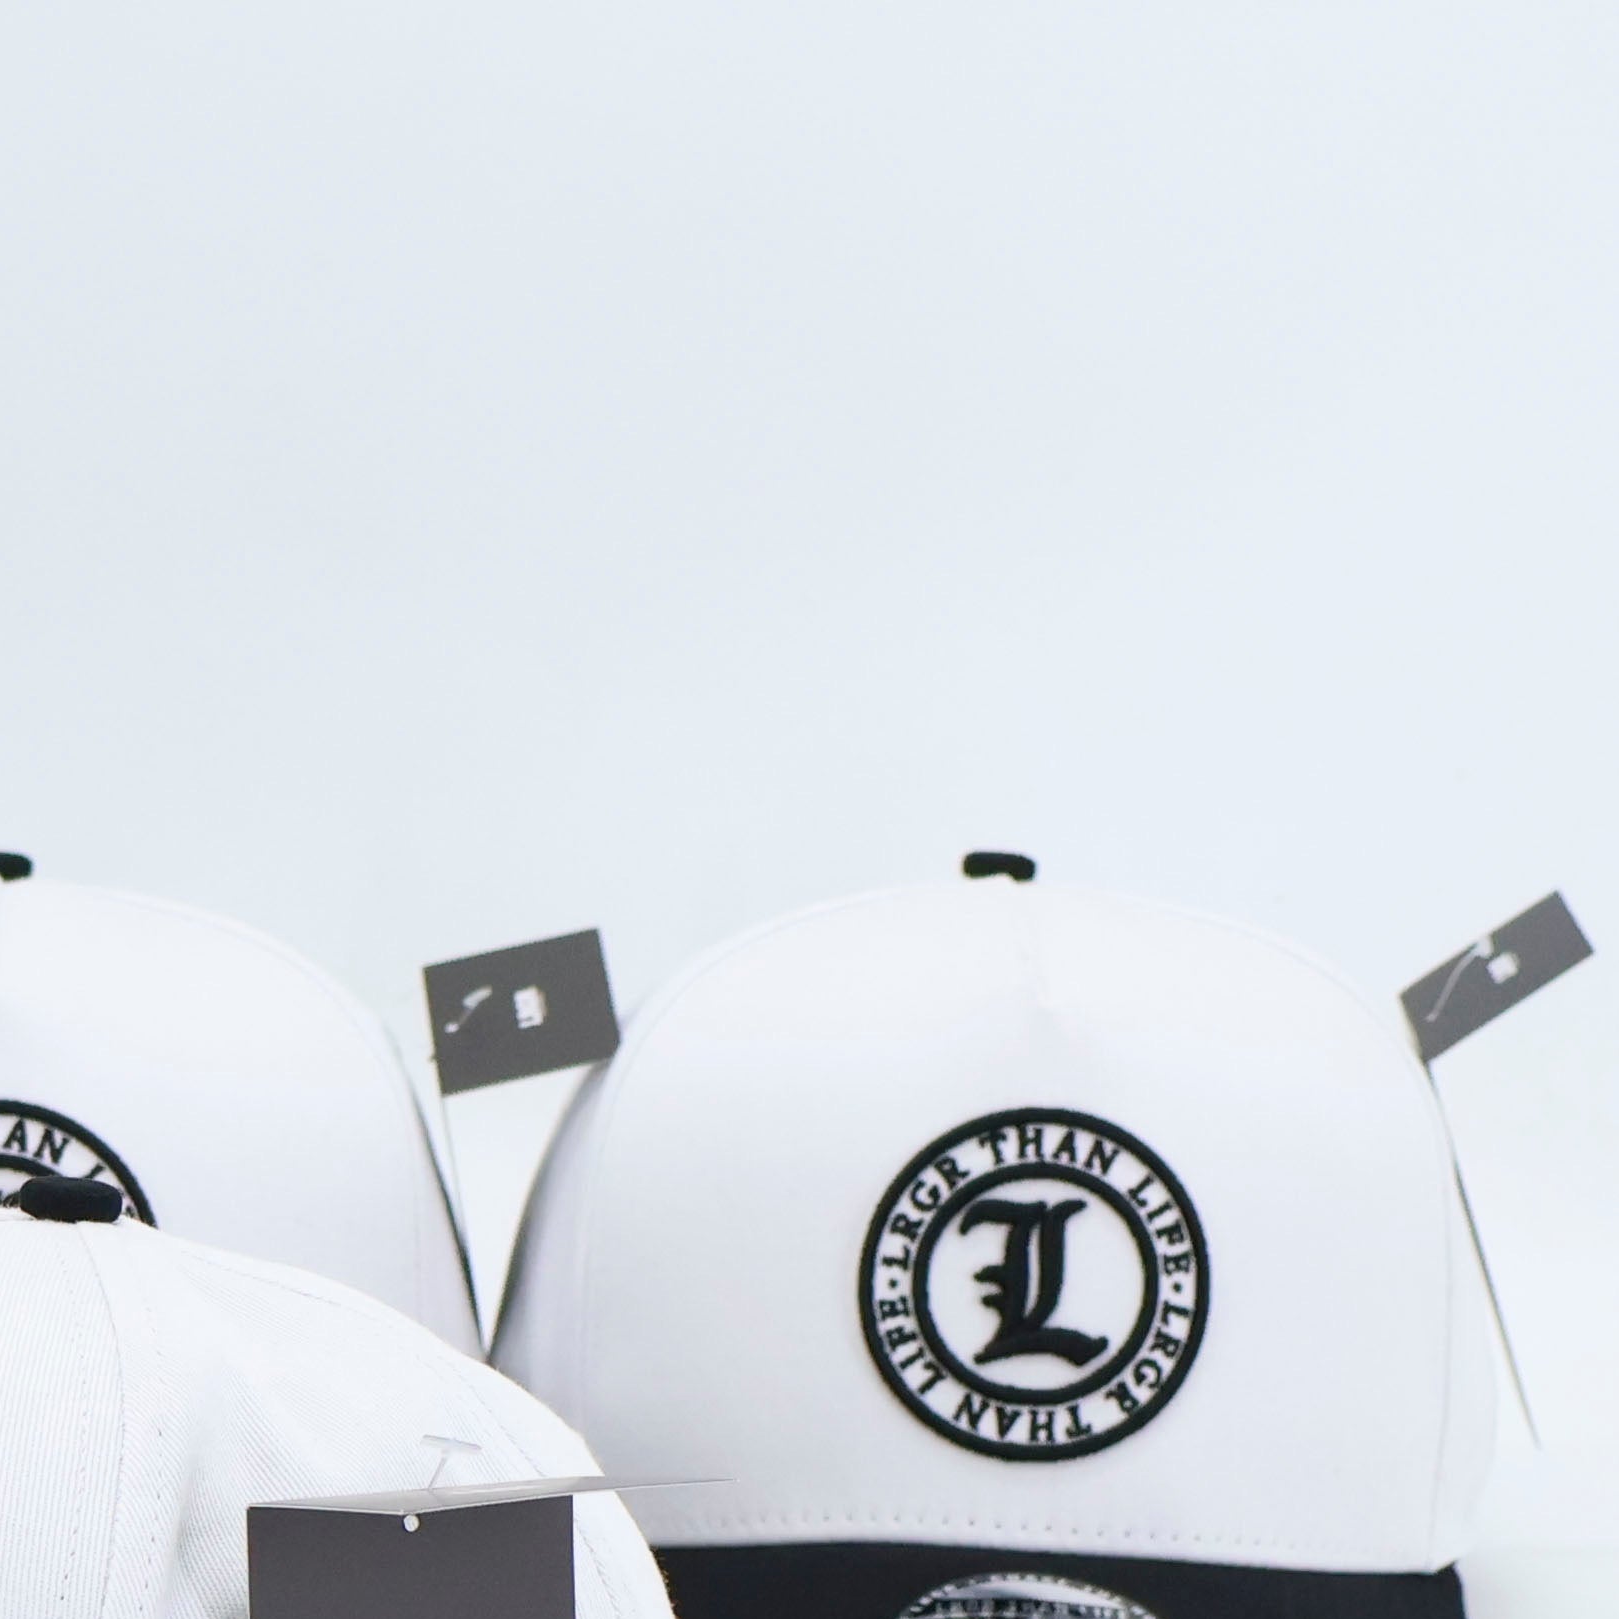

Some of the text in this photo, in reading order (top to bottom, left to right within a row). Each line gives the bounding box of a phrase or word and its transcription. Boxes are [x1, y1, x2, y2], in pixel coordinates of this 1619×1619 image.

[882, 1125, 1192, 1276] LRGR THAN LIFE
[878, 1295, 1190, 1444] LRGR THAN LIFE
